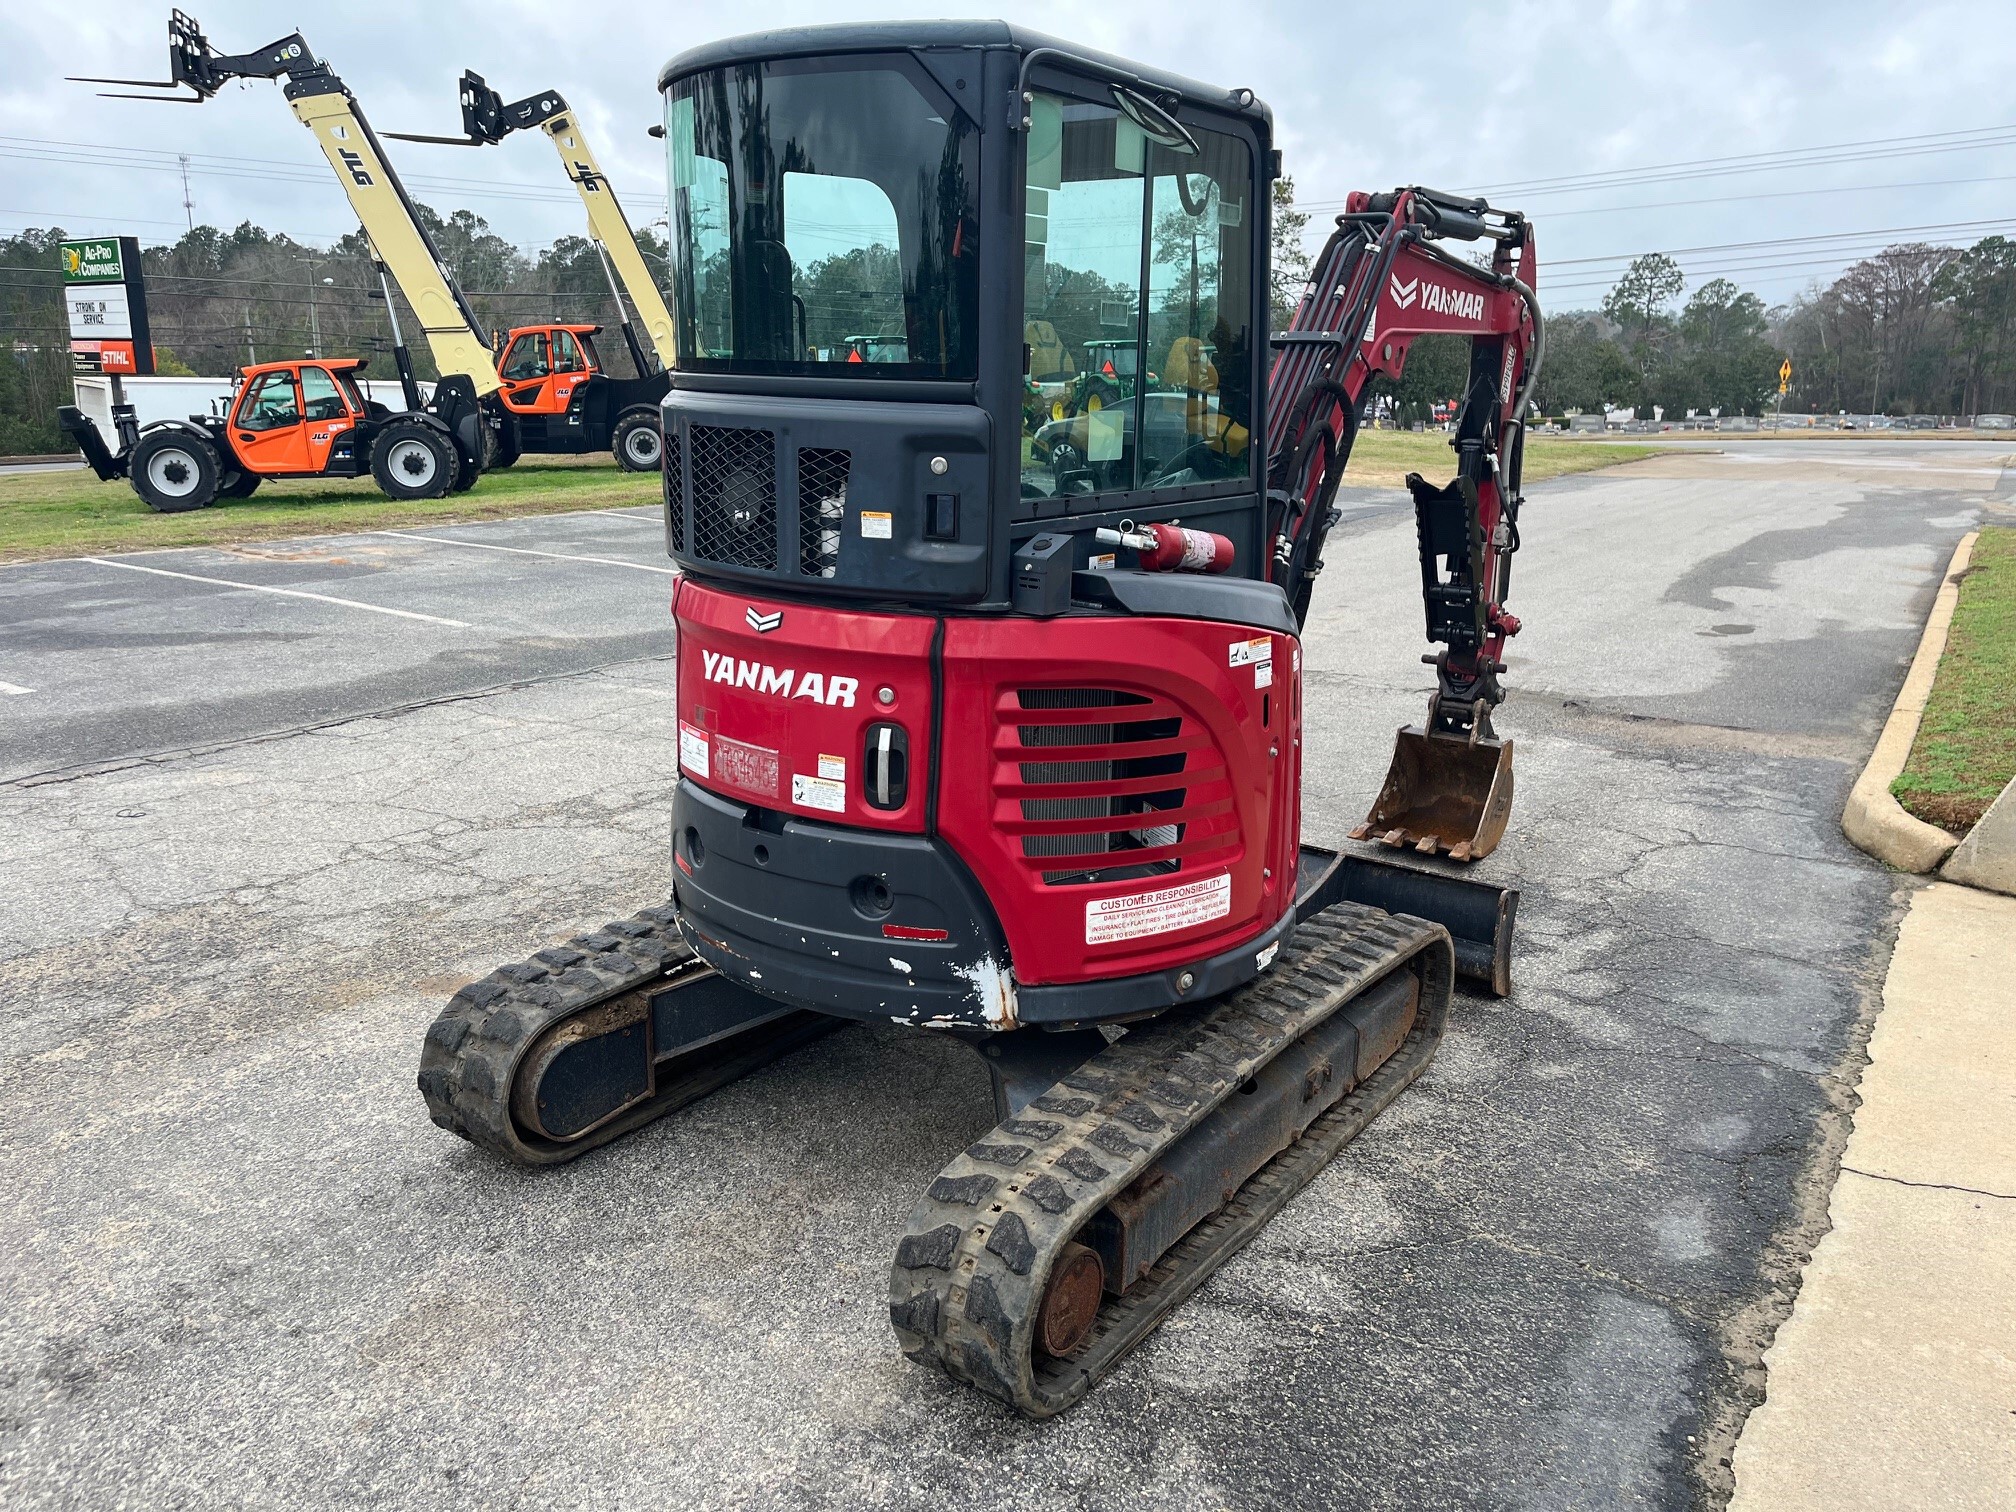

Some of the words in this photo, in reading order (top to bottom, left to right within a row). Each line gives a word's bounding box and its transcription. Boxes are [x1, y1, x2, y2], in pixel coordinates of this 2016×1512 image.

[338, 148, 375, 186] JLG
[574, 161, 600, 191] JLG
[75, 302, 95, 312] STRONG
[99, 302, 107, 312] ON
[1421, 280, 1484, 321] YANMAR
[83, 314, 104, 324] SERVICE
[102, 351, 129, 365] STIHL
[702, 649, 859, 708] YANMAR
[1100, 894, 1153, 910] CUSTOMER
[1155, 878, 1221, 901] RESPONSIBILITY
[1091, 922, 1127, 932] INSURANCE
[1130, 919, 1144, 927] FLAT
[1164, 912, 1176, 920] TIRE
[1177, 907, 1198, 917] DAMAGE
[1121, 909, 1145, 919] SERVICE
[1146, 907, 1158, 915] AND
[1158, 901, 1185, 912] CLEANING
[1088, 933, 1115, 942] DAMAGE
[1124, 926, 1156, 937] EQUIPMENT
[1160, 921, 1183, 930] BATTERY
